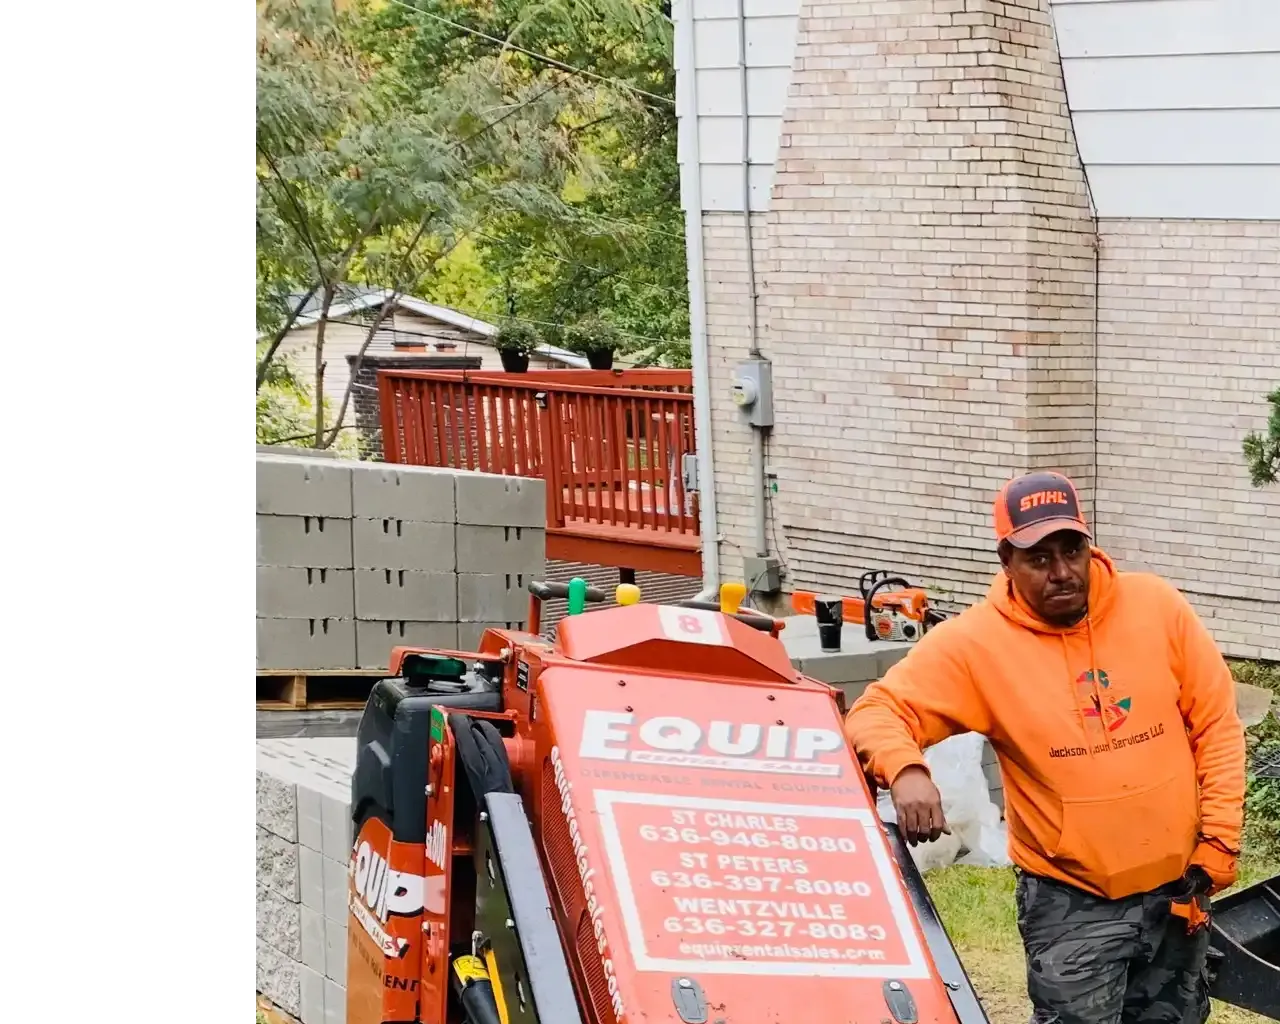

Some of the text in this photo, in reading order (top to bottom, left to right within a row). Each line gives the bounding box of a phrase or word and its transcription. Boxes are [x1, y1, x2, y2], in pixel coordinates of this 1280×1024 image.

[1020, 490, 1068, 512] STIHL
[677, 615, 703, 634] 8
[578, 709, 845, 761] EQUIP
[1048, 746, 1088, 758] Jackson
[1111, 730, 1150, 750] Services
[1149, 723, 1165, 738] LLC
[772, 782, 860, 796] EQUIPMEN
[671, 810, 800, 832] ST CHARLES
[639, 825, 857, 853] 636-946-8080
[679, 852, 809, 875] ST PETERS
[650, 870, 872, 897] 636-397-8080
[673, 897, 847, 921] WENTZVILLE
[679, 941, 886, 961] equiprentalsales.com
